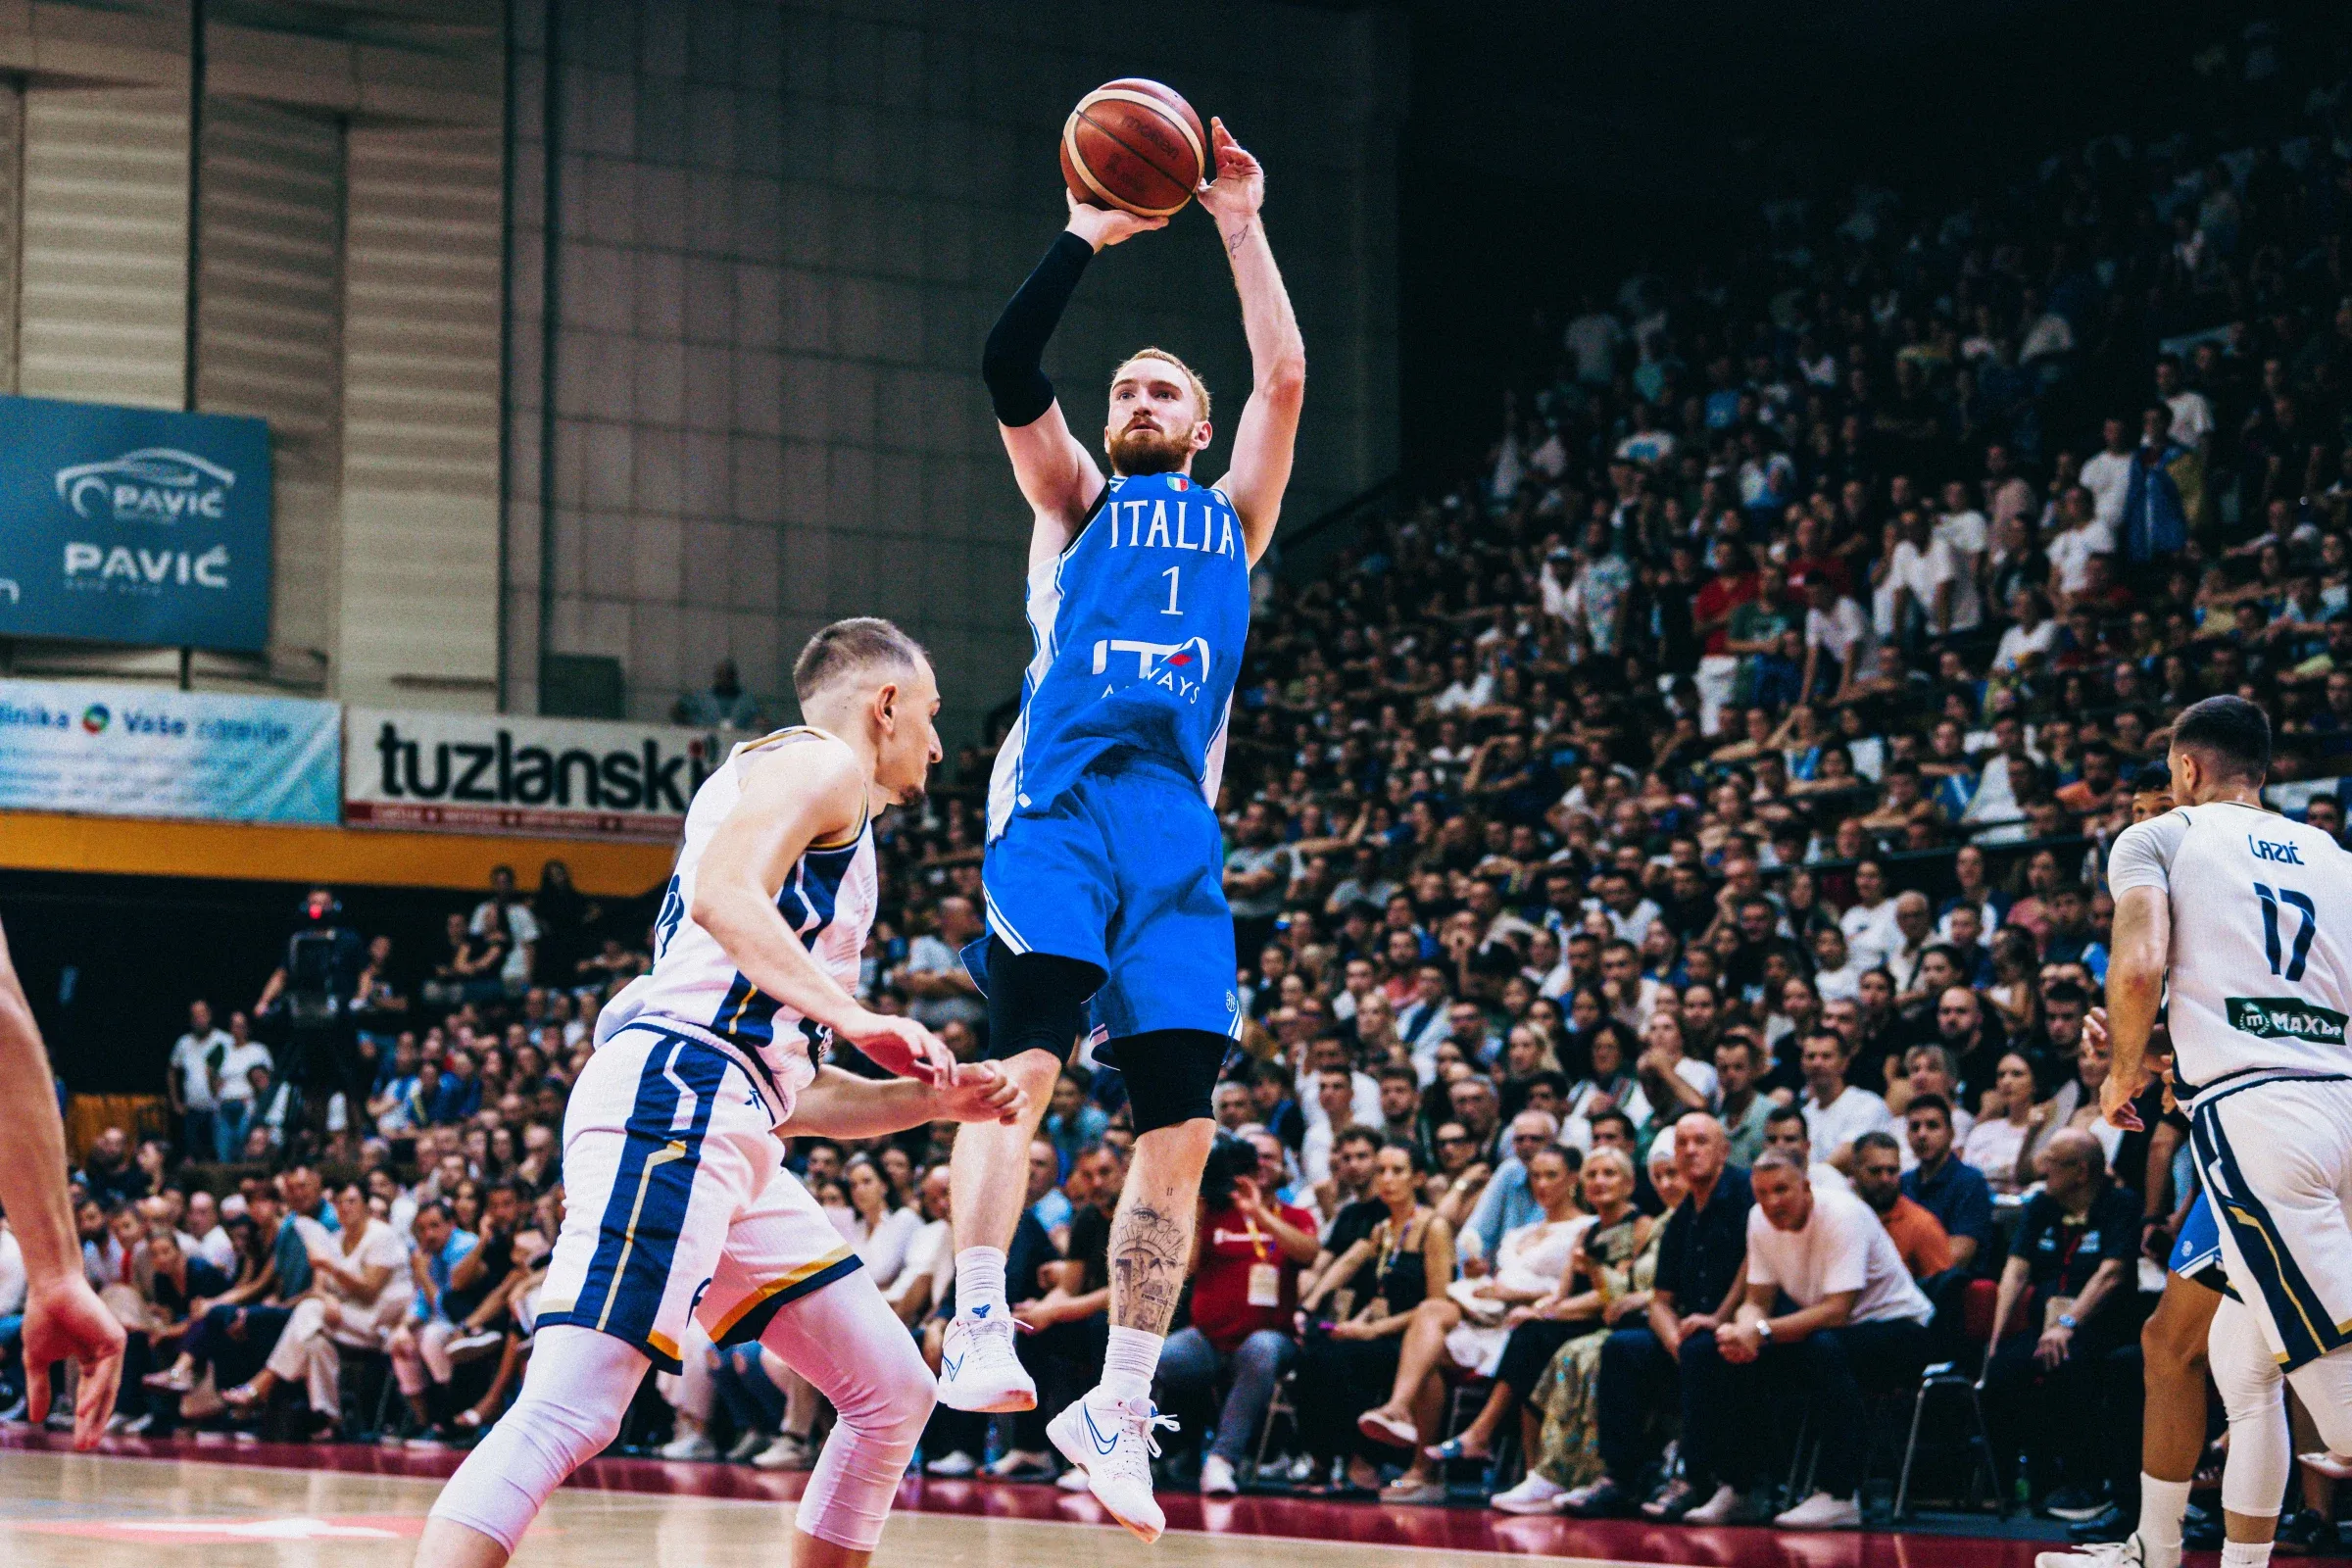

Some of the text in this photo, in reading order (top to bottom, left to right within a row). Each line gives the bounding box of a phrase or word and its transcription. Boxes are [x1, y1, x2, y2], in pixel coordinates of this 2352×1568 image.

[1108, 499, 1235, 562] ITALIA
[64, 541, 230, 589] PAVIĆ
[1160, 565, 1184, 616] 1
[2247, 834, 2305, 866] LAZIĆ
[2253, 882, 2317, 982] 17
